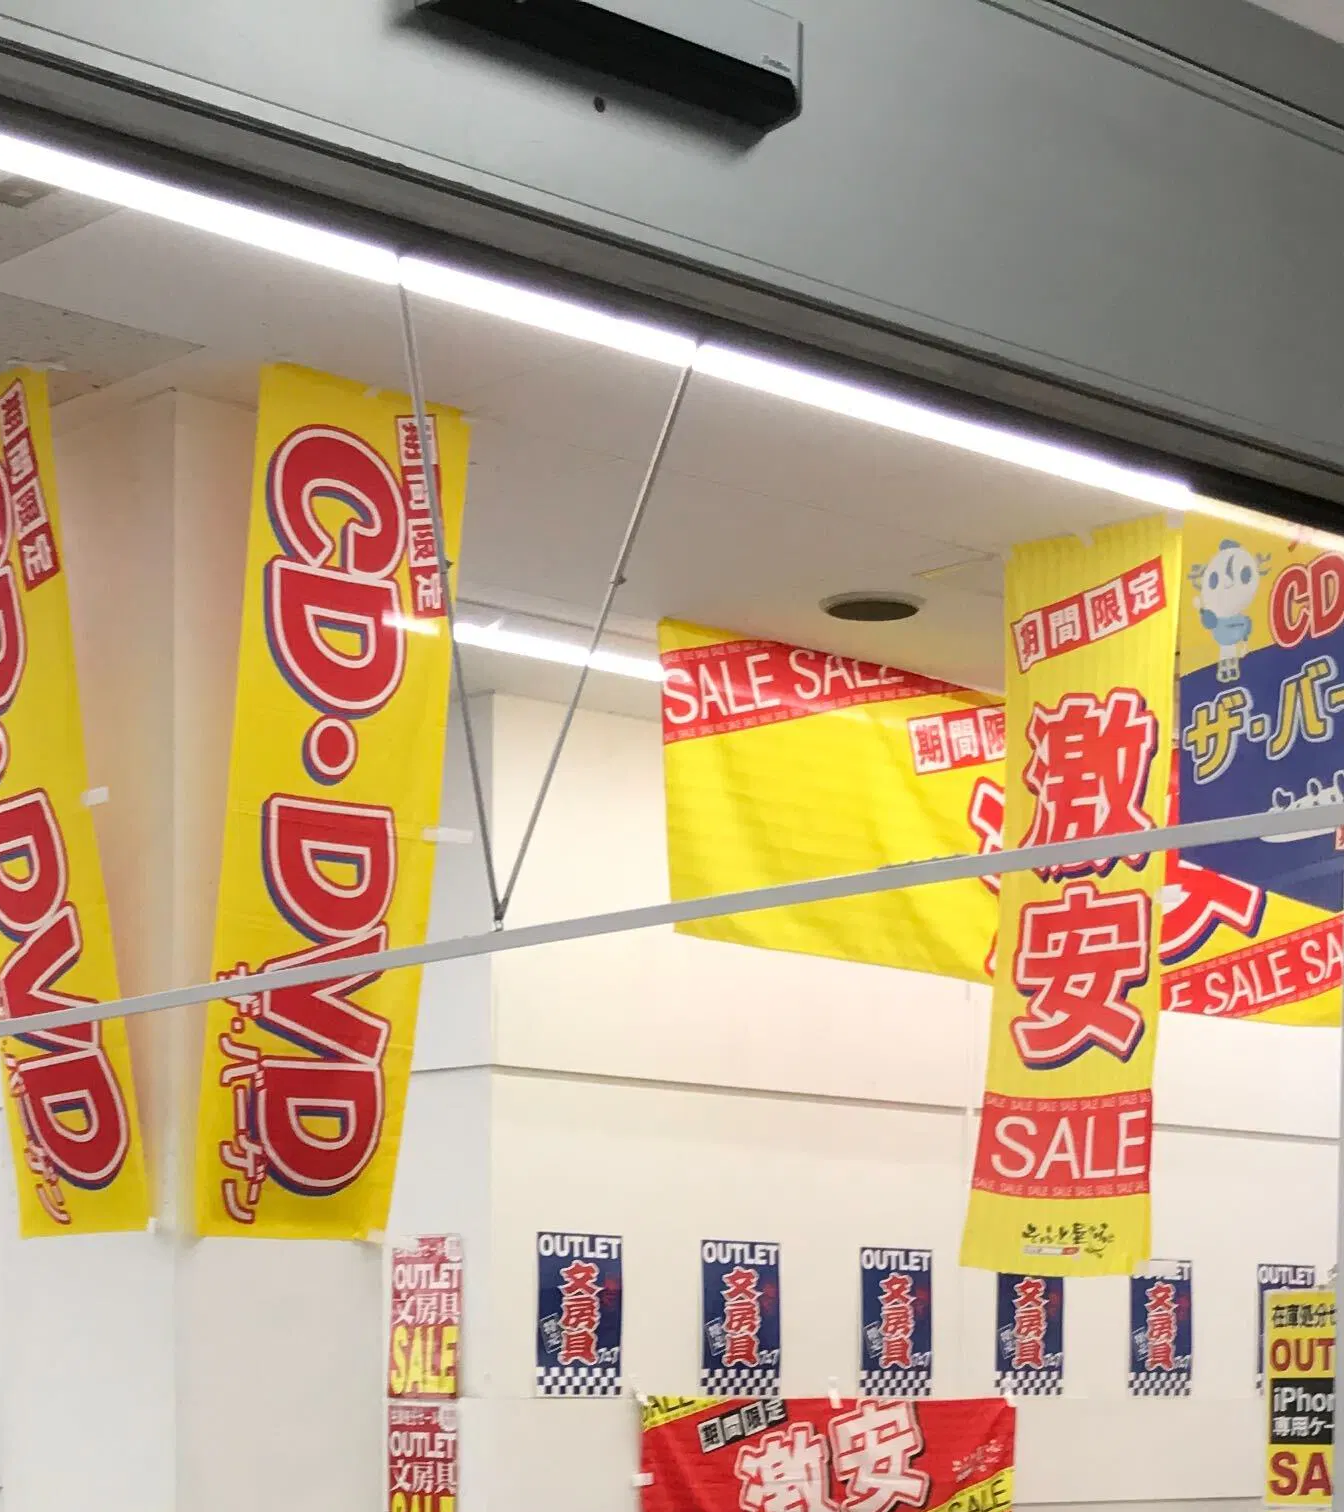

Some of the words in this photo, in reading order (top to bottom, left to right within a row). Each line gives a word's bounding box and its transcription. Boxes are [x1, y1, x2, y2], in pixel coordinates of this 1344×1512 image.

[1015, 565, 1163, 668] 期間限定
[663, 653, 782, 724] SALE
[912, 707, 1004, 767] 期間限
[1010, 686, 1158, 1070] 激安
[1203, 949, 1296, 1015] SALE
[1301, 932, 1344, 985] SA
[991, 1110, 1147, 1179] SALE
[539, 1234, 620, 1259] OUTLET
[703, 1242, 778, 1265] OUTLET
[862, 1249, 931, 1271] OUTLET
[395, 1263, 463, 1289] OUTLET
[1258, 1267, 1314, 1286] OUTLET
[392, 1292, 461, 1325] 文房具
[1272, 1304, 1336, 1328] 在庫処分
[391, 1326, 459, 1394] SALE
[1270, 1338, 1336, 1372] OUT
[700, 1400, 787, 1451] 期間限定
[1273, 1415, 1334, 1438] 専用ケー
[390, 1431, 456, 1458] OUTLET
[389, 1460, 457, 1493] 文房具
[1269, 1452, 1332, 1497] SA
